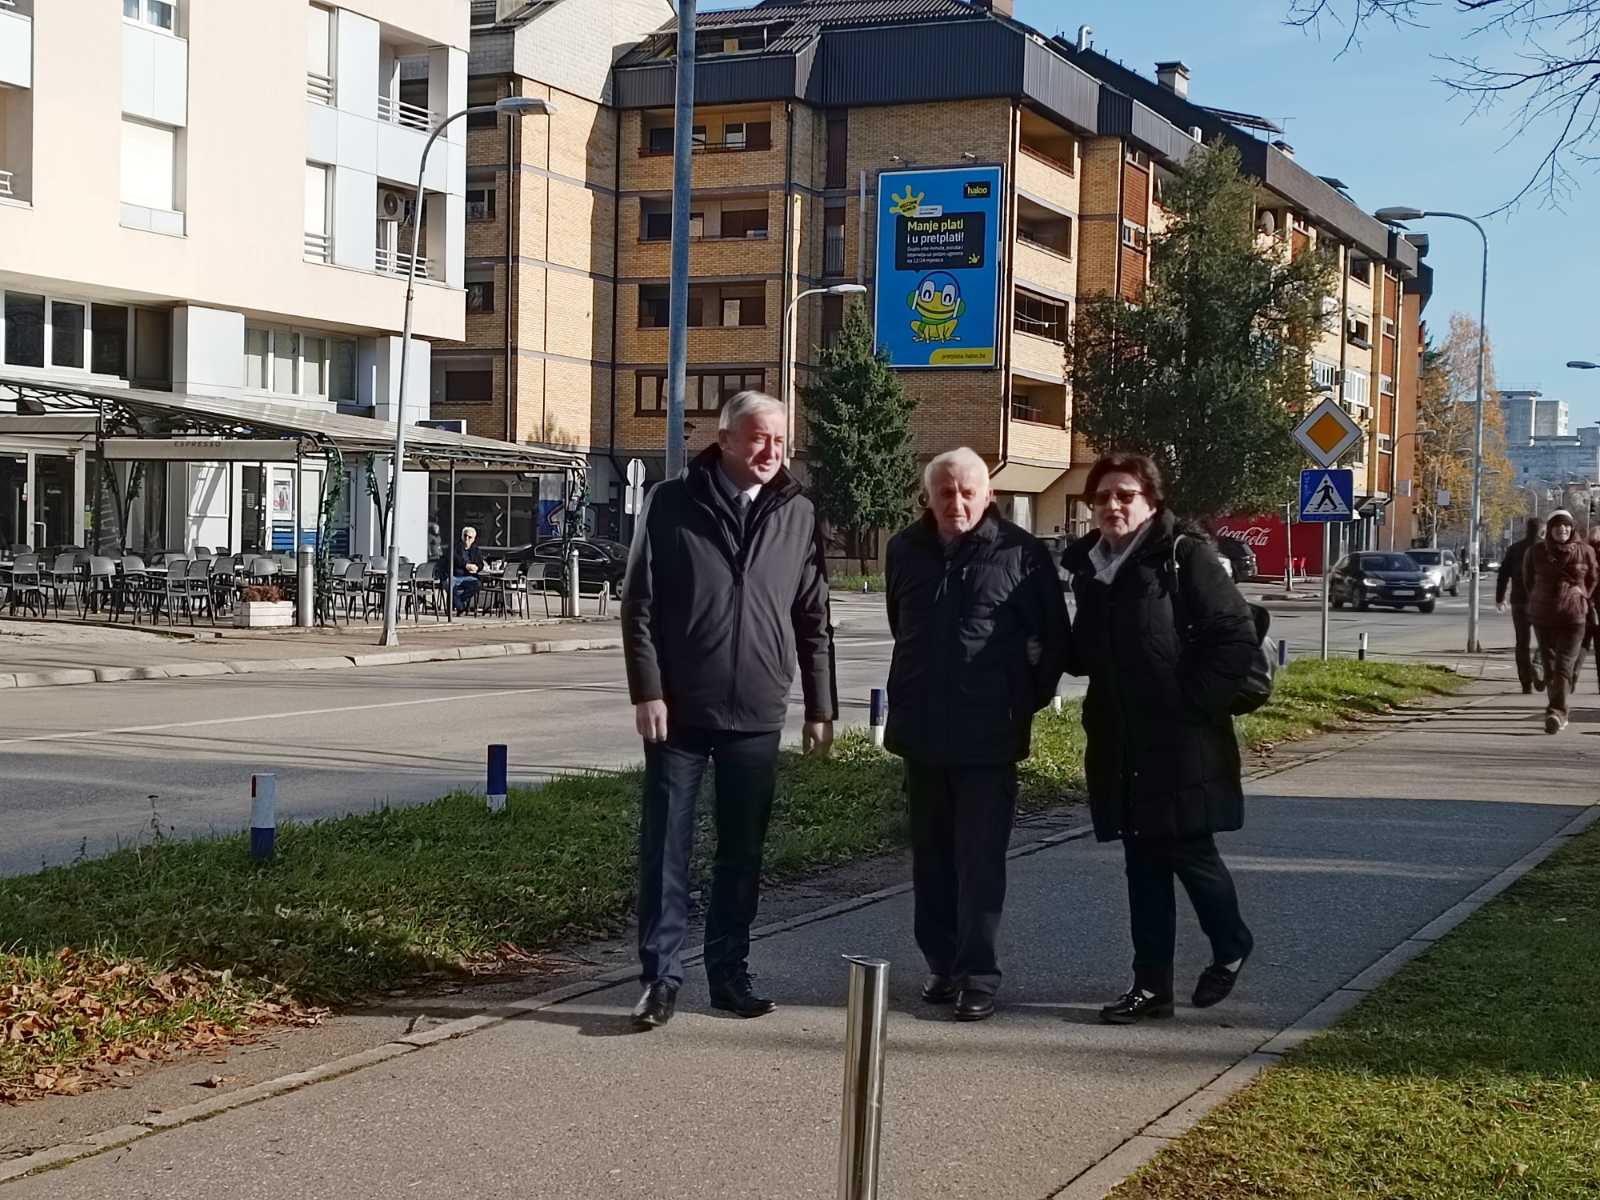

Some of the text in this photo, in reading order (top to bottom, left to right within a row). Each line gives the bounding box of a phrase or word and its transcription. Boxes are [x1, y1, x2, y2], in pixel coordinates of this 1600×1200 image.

[907, 218, 964, 233] Manje plati
[912, 236, 918, 244] u
